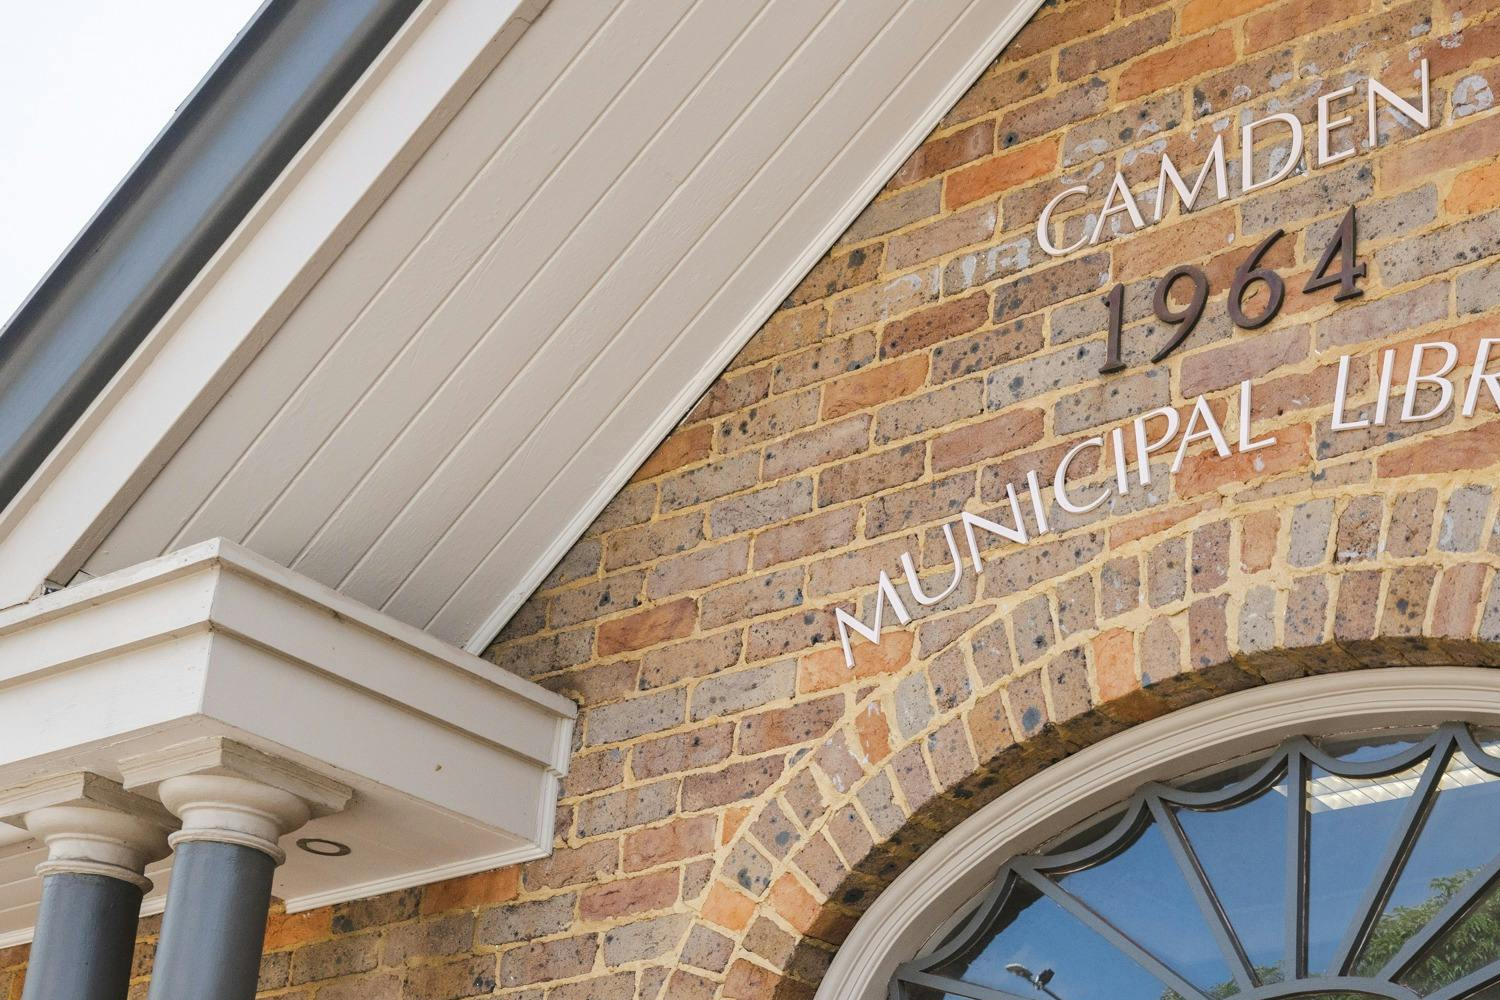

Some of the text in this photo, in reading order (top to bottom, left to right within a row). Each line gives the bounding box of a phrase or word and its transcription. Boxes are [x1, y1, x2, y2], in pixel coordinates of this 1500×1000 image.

[1036, 58, 1431, 257] CAMDEN
[1099, 205, 1368, 374] 1964
[833, 380, 1277, 669] MUNICIPAL
